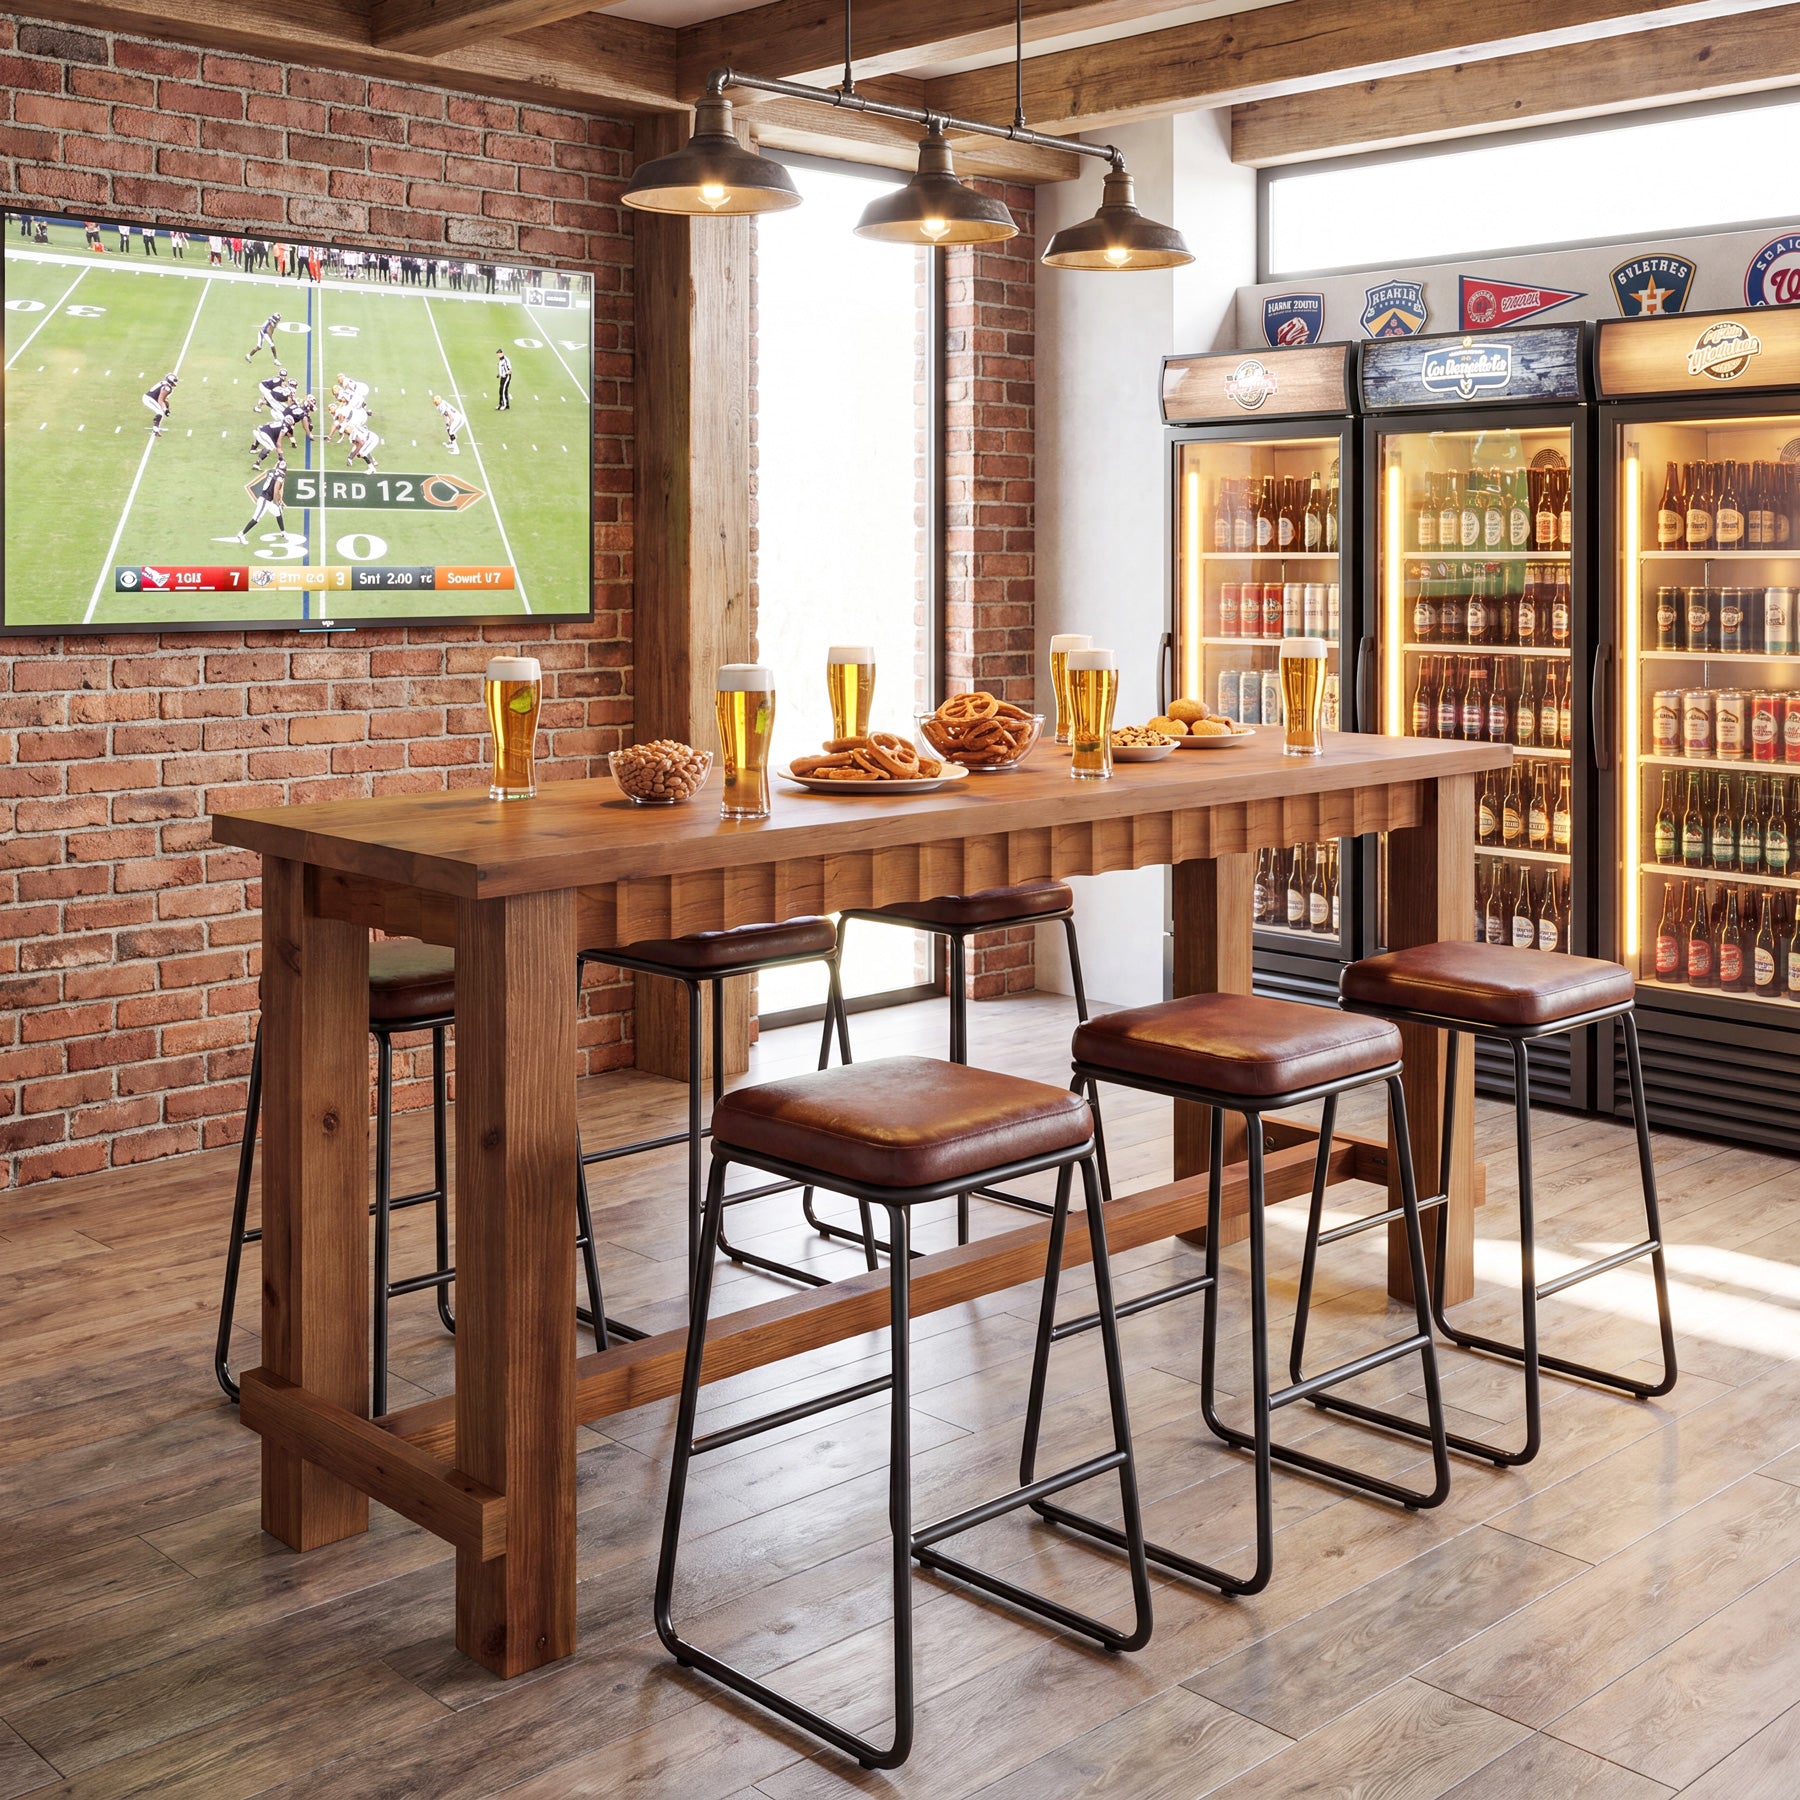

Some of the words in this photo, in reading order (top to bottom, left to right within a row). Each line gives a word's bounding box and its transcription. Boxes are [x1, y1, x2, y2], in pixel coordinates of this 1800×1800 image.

[376, 480, 415, 501] 12
[229, 572, 240, 586] 7
[335, 571, 345, 586] 3
